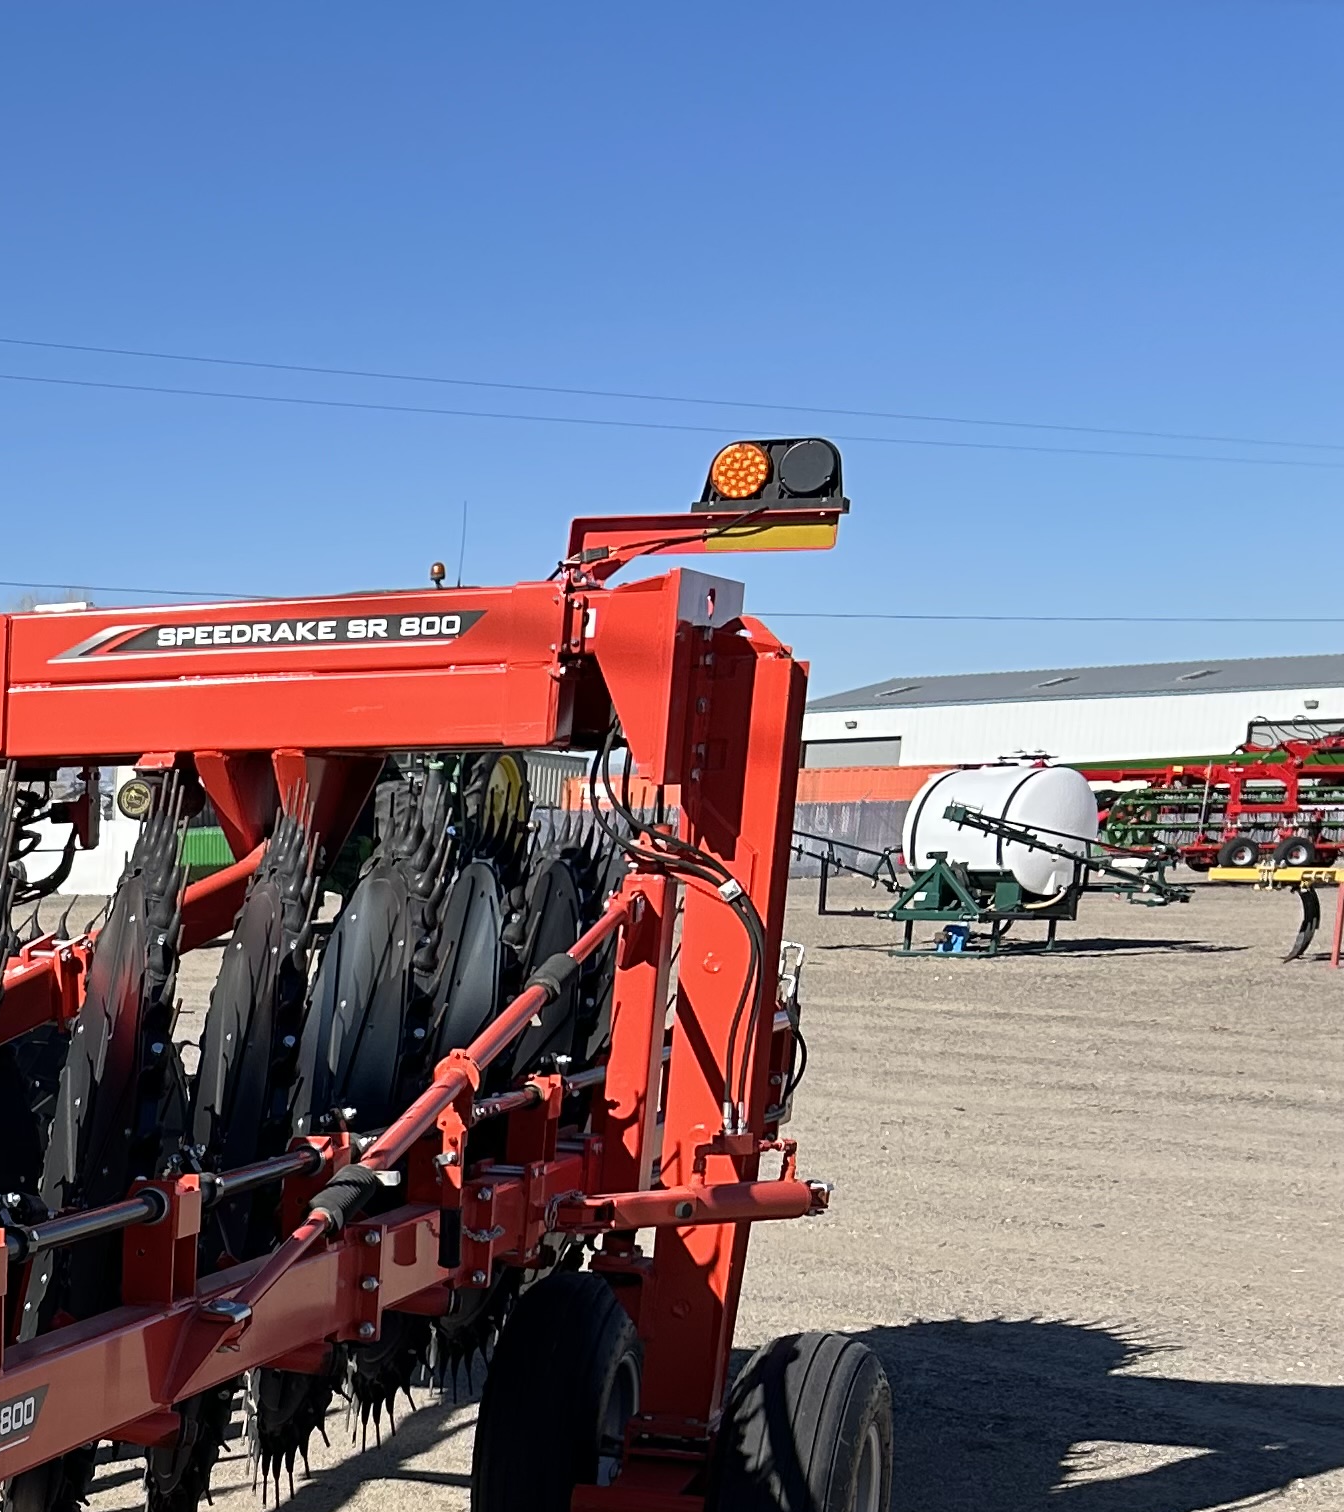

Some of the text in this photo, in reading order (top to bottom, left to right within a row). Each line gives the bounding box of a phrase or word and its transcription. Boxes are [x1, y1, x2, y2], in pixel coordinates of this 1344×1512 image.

[156, 615, 461, 647] SPEEDRAKE SR 800
[0, 1396, 35, 1436] 800
